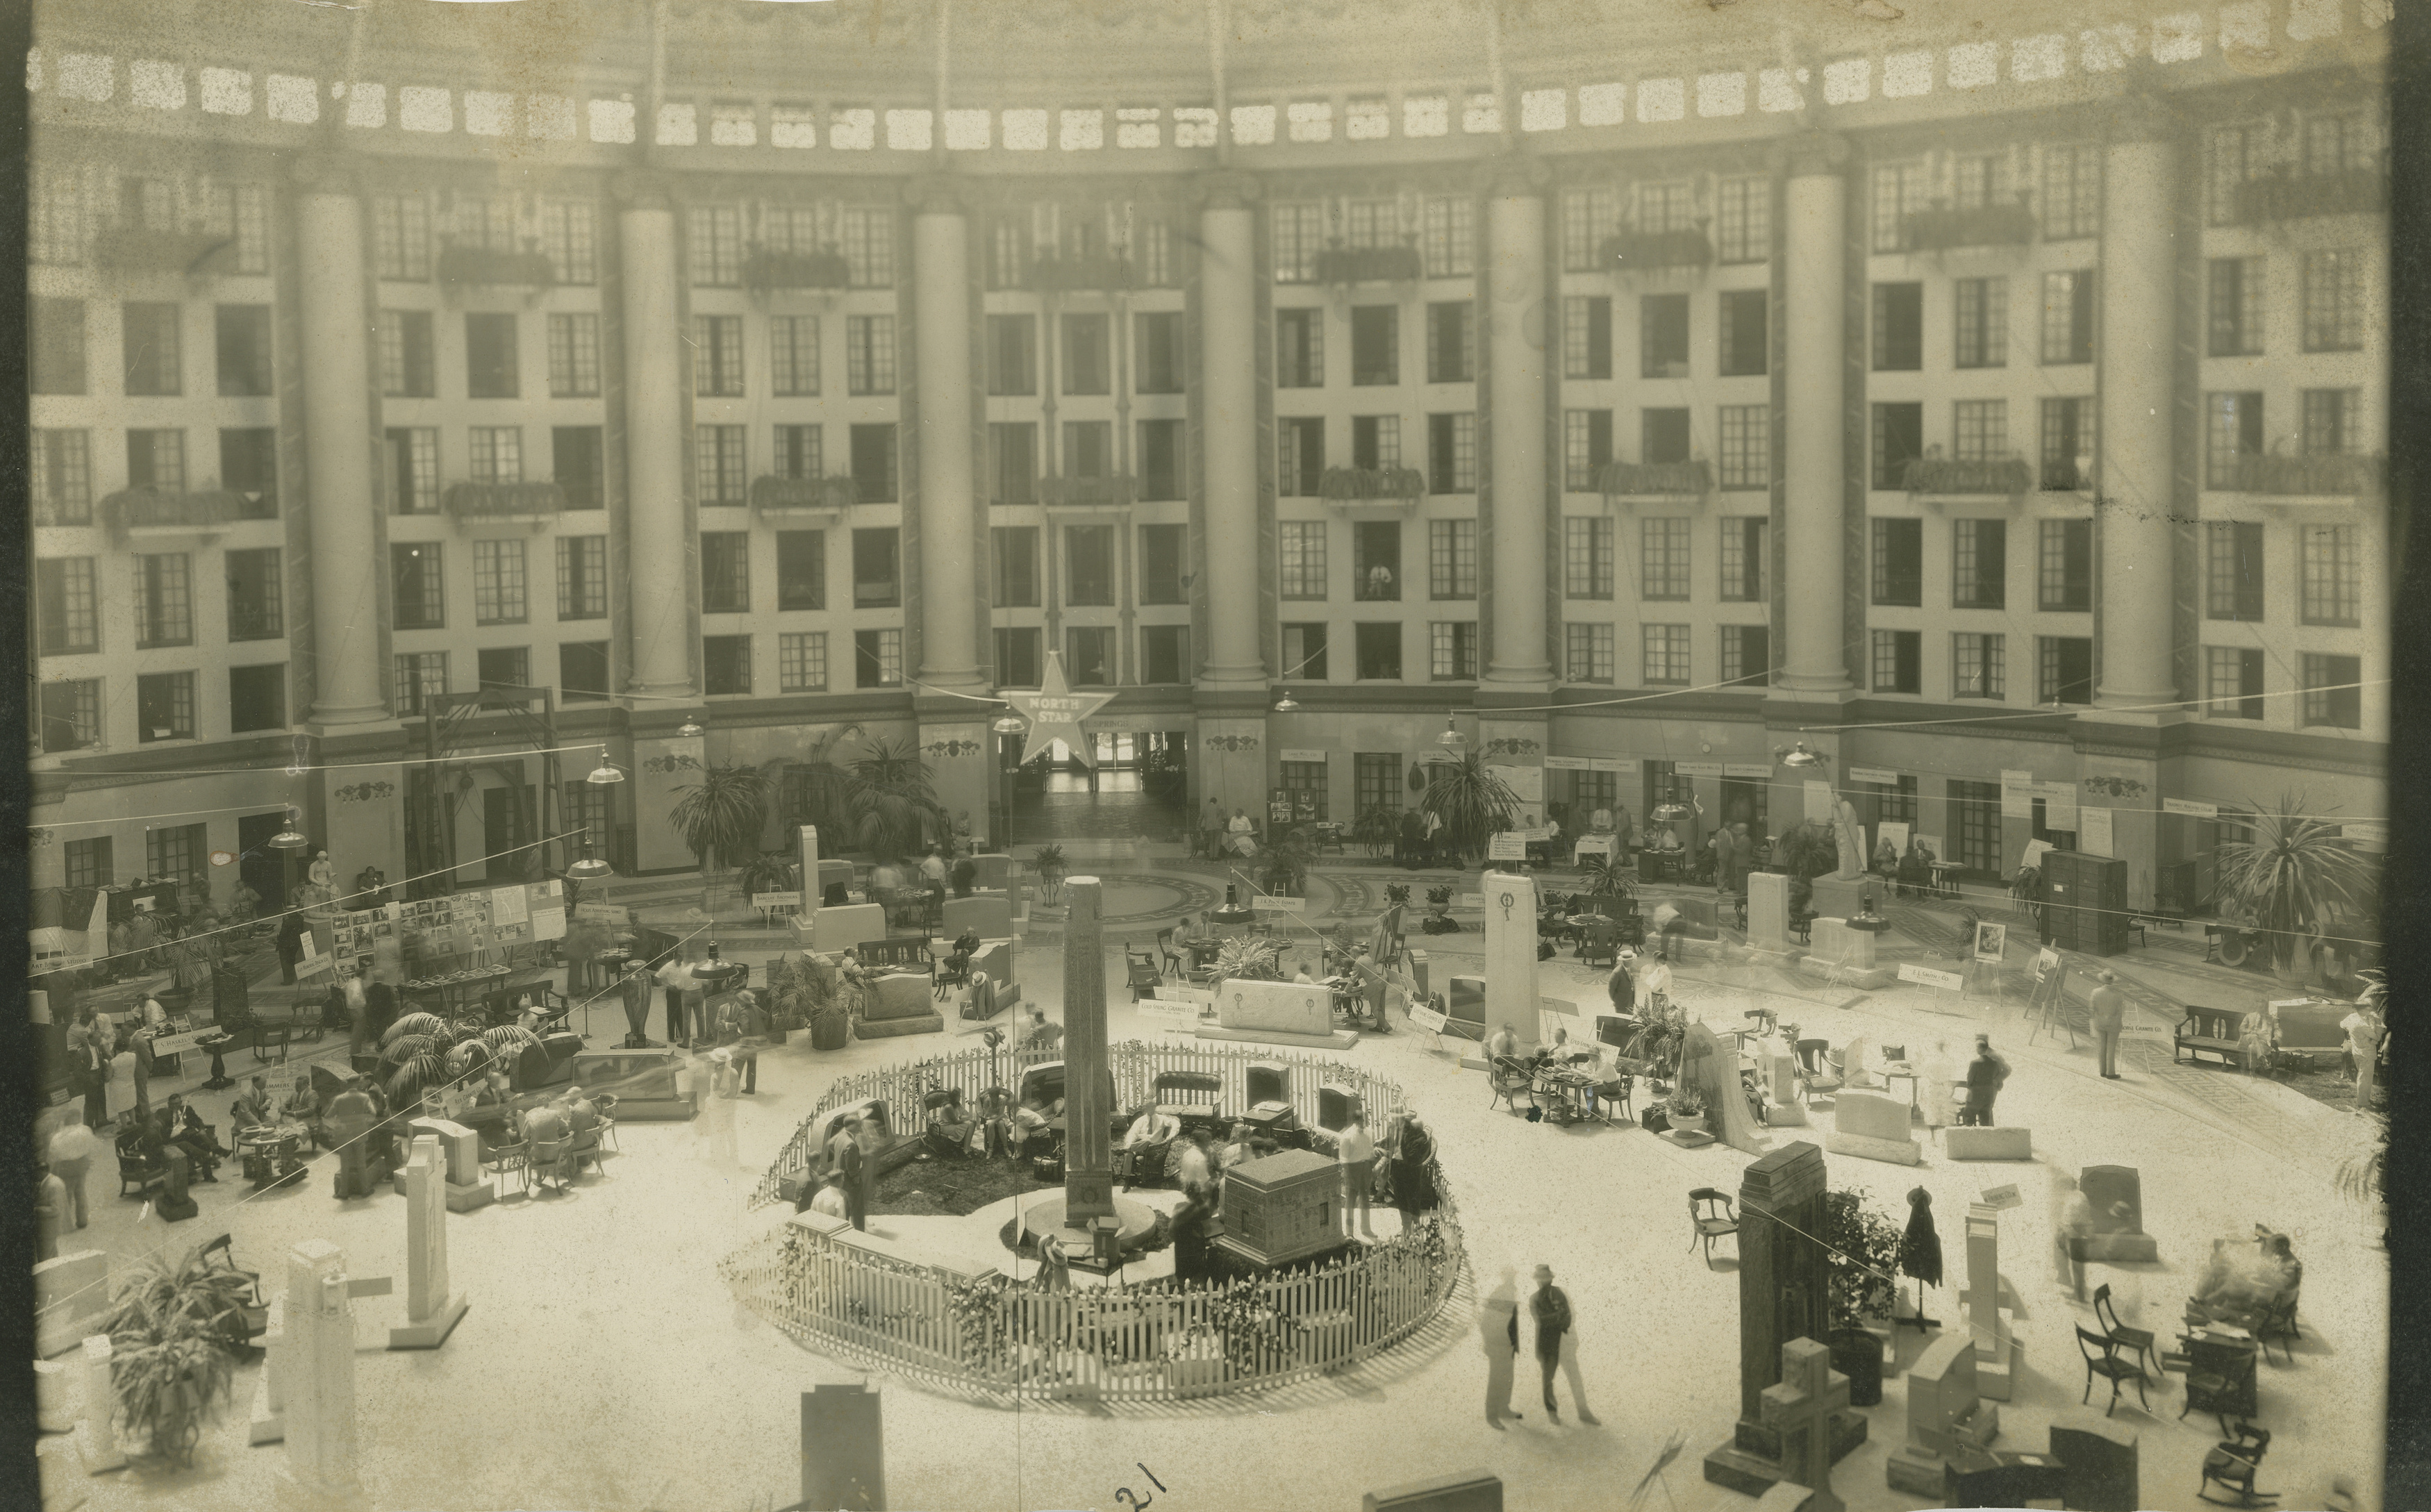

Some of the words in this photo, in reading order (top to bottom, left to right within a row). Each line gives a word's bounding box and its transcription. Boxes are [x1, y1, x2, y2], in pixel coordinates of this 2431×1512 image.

[1029, 697, 1079, 710] NORTH
[1038, 711, 1073, 723] STAR
[167, 1038, 187, 1047] HASKEL
[463, 1089, 476, 1101] GRANITE
